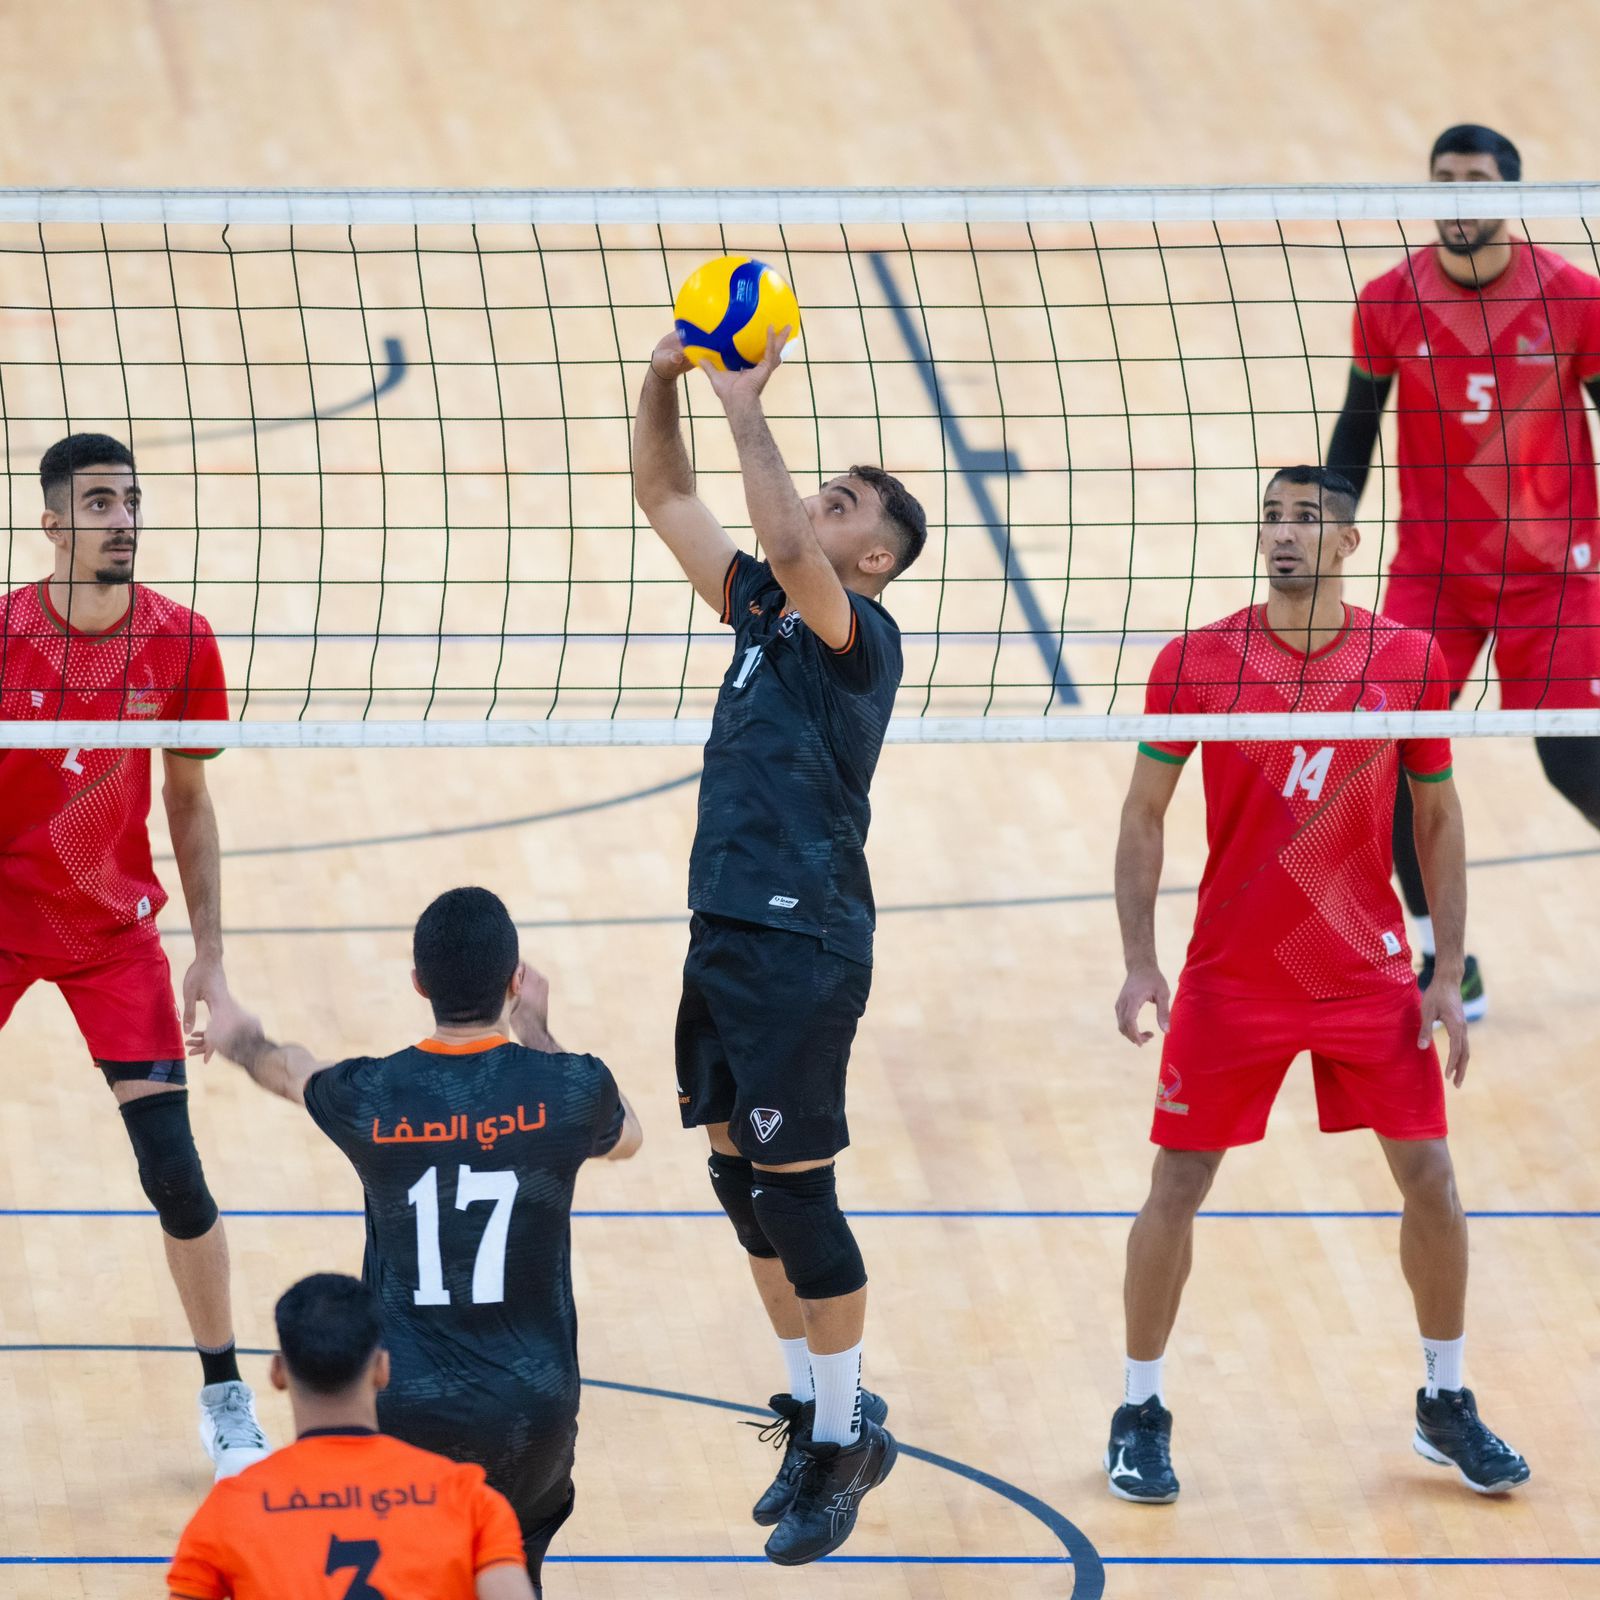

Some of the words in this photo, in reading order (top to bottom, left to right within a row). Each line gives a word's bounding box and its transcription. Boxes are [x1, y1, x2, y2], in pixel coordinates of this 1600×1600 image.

[1461, 373, 1496, 424] 5
[1281, 745, 1336, 801] 14
[372, 1114, 468, 1144] الصفا
[475, 1102, 546, 1151] نادي
[408, 1164, 519, 1305] 17
[262, 1485, 362, 1513] الصفا
[371, 1484, 438, 1520] نادي
